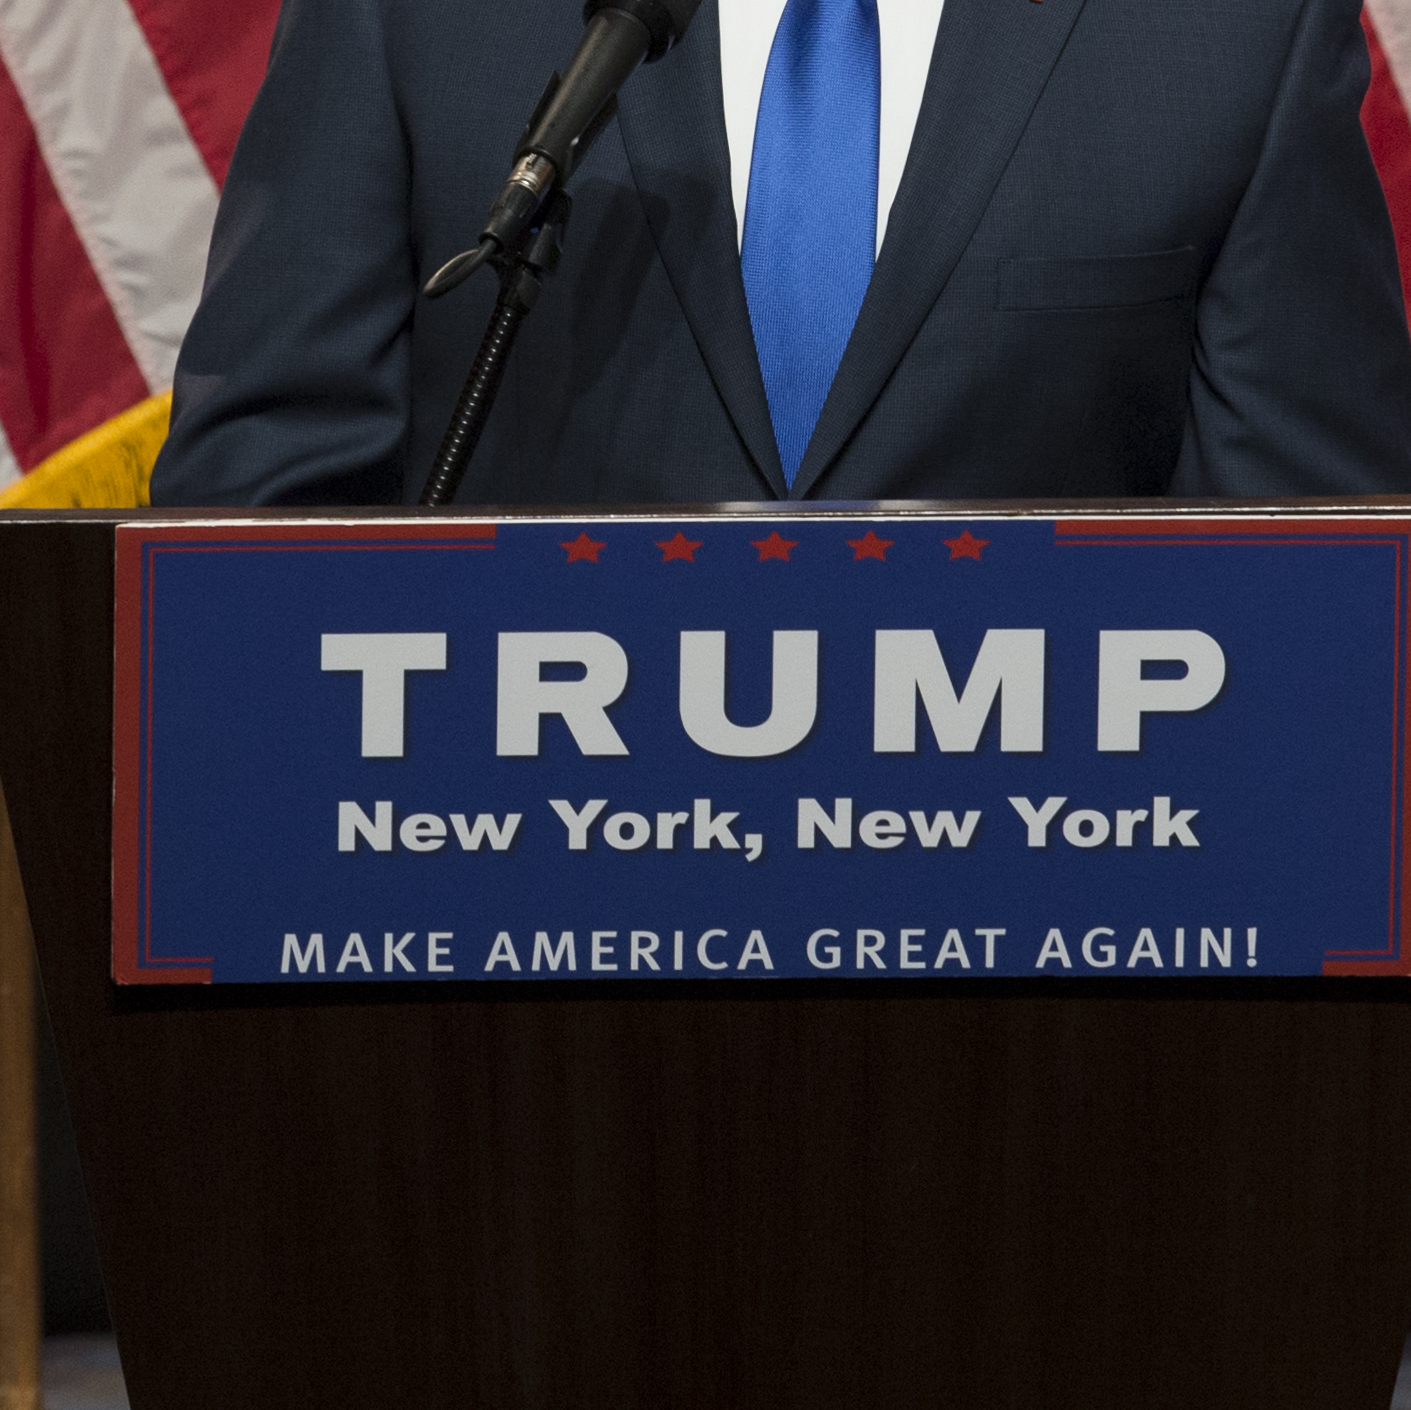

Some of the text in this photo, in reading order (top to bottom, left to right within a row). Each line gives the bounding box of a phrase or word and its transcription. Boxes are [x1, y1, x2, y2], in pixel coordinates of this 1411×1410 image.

[319, 628, 1227, 758] TRUMP
[336, 795, 1201, 863] New York, New York
[279, 926, 1258, 975] MAKE AMERICA GREAT AGAIN!
